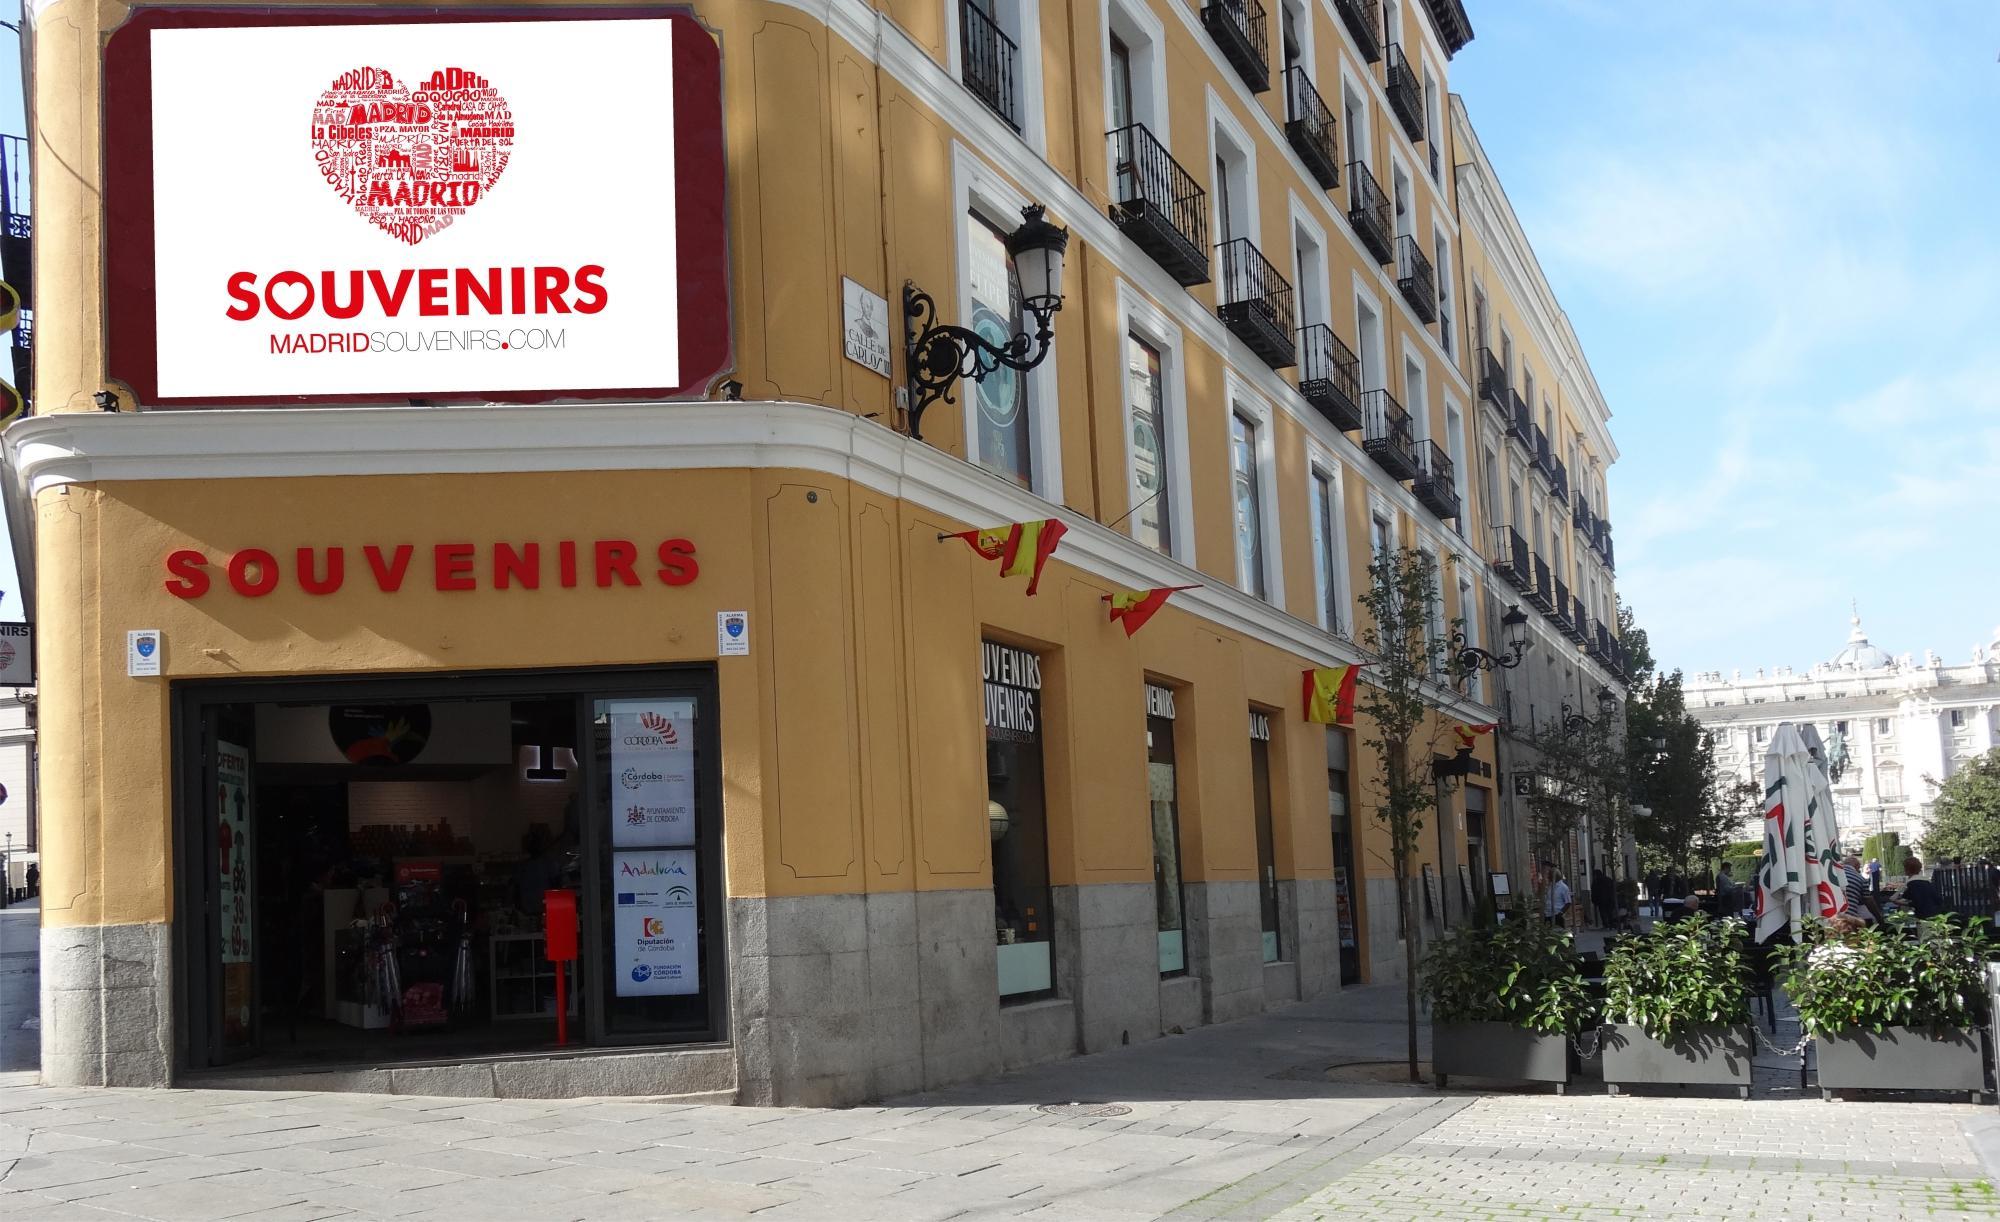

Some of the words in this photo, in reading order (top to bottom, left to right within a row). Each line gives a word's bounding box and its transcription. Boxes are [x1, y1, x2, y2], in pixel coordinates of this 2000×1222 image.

[332, 66, 376, 91] MADRID
[420, 68, 488, 91] MADRID
[313, 114, 346, 125] MAD
[346, 102, 433, 124] MADRID
[485, 111, 512, 120] MAD
[312, 125, 324, 139] La
[329, 125, 372, 140] Cibeles
[460, 128, 514, 137] MADRID
[438, 122, 450, 181] MADRID
[315, 149, 355, 205] MADRID
[449, 172, 479, 180] madrid
[484, 155, 509, 192] MADRID
[356, 168, 368, 206] Palacio
[366, 180, 480, 207] MADRID
[380, 223, 423, 246] MADRID
[423, 215, 453, 239] MAD
[226, 264, 608, 322] SOUVENIRS
[270, 328, 566, 354] MADRIDSOUVENIRS.COM
[848, 328, 876, 352] CALLE
[846, 341, 882, 370] CARLOS
[164, 538, 700, 599] SOUVENIRS
[638, 938, 674, 946] Diputación
